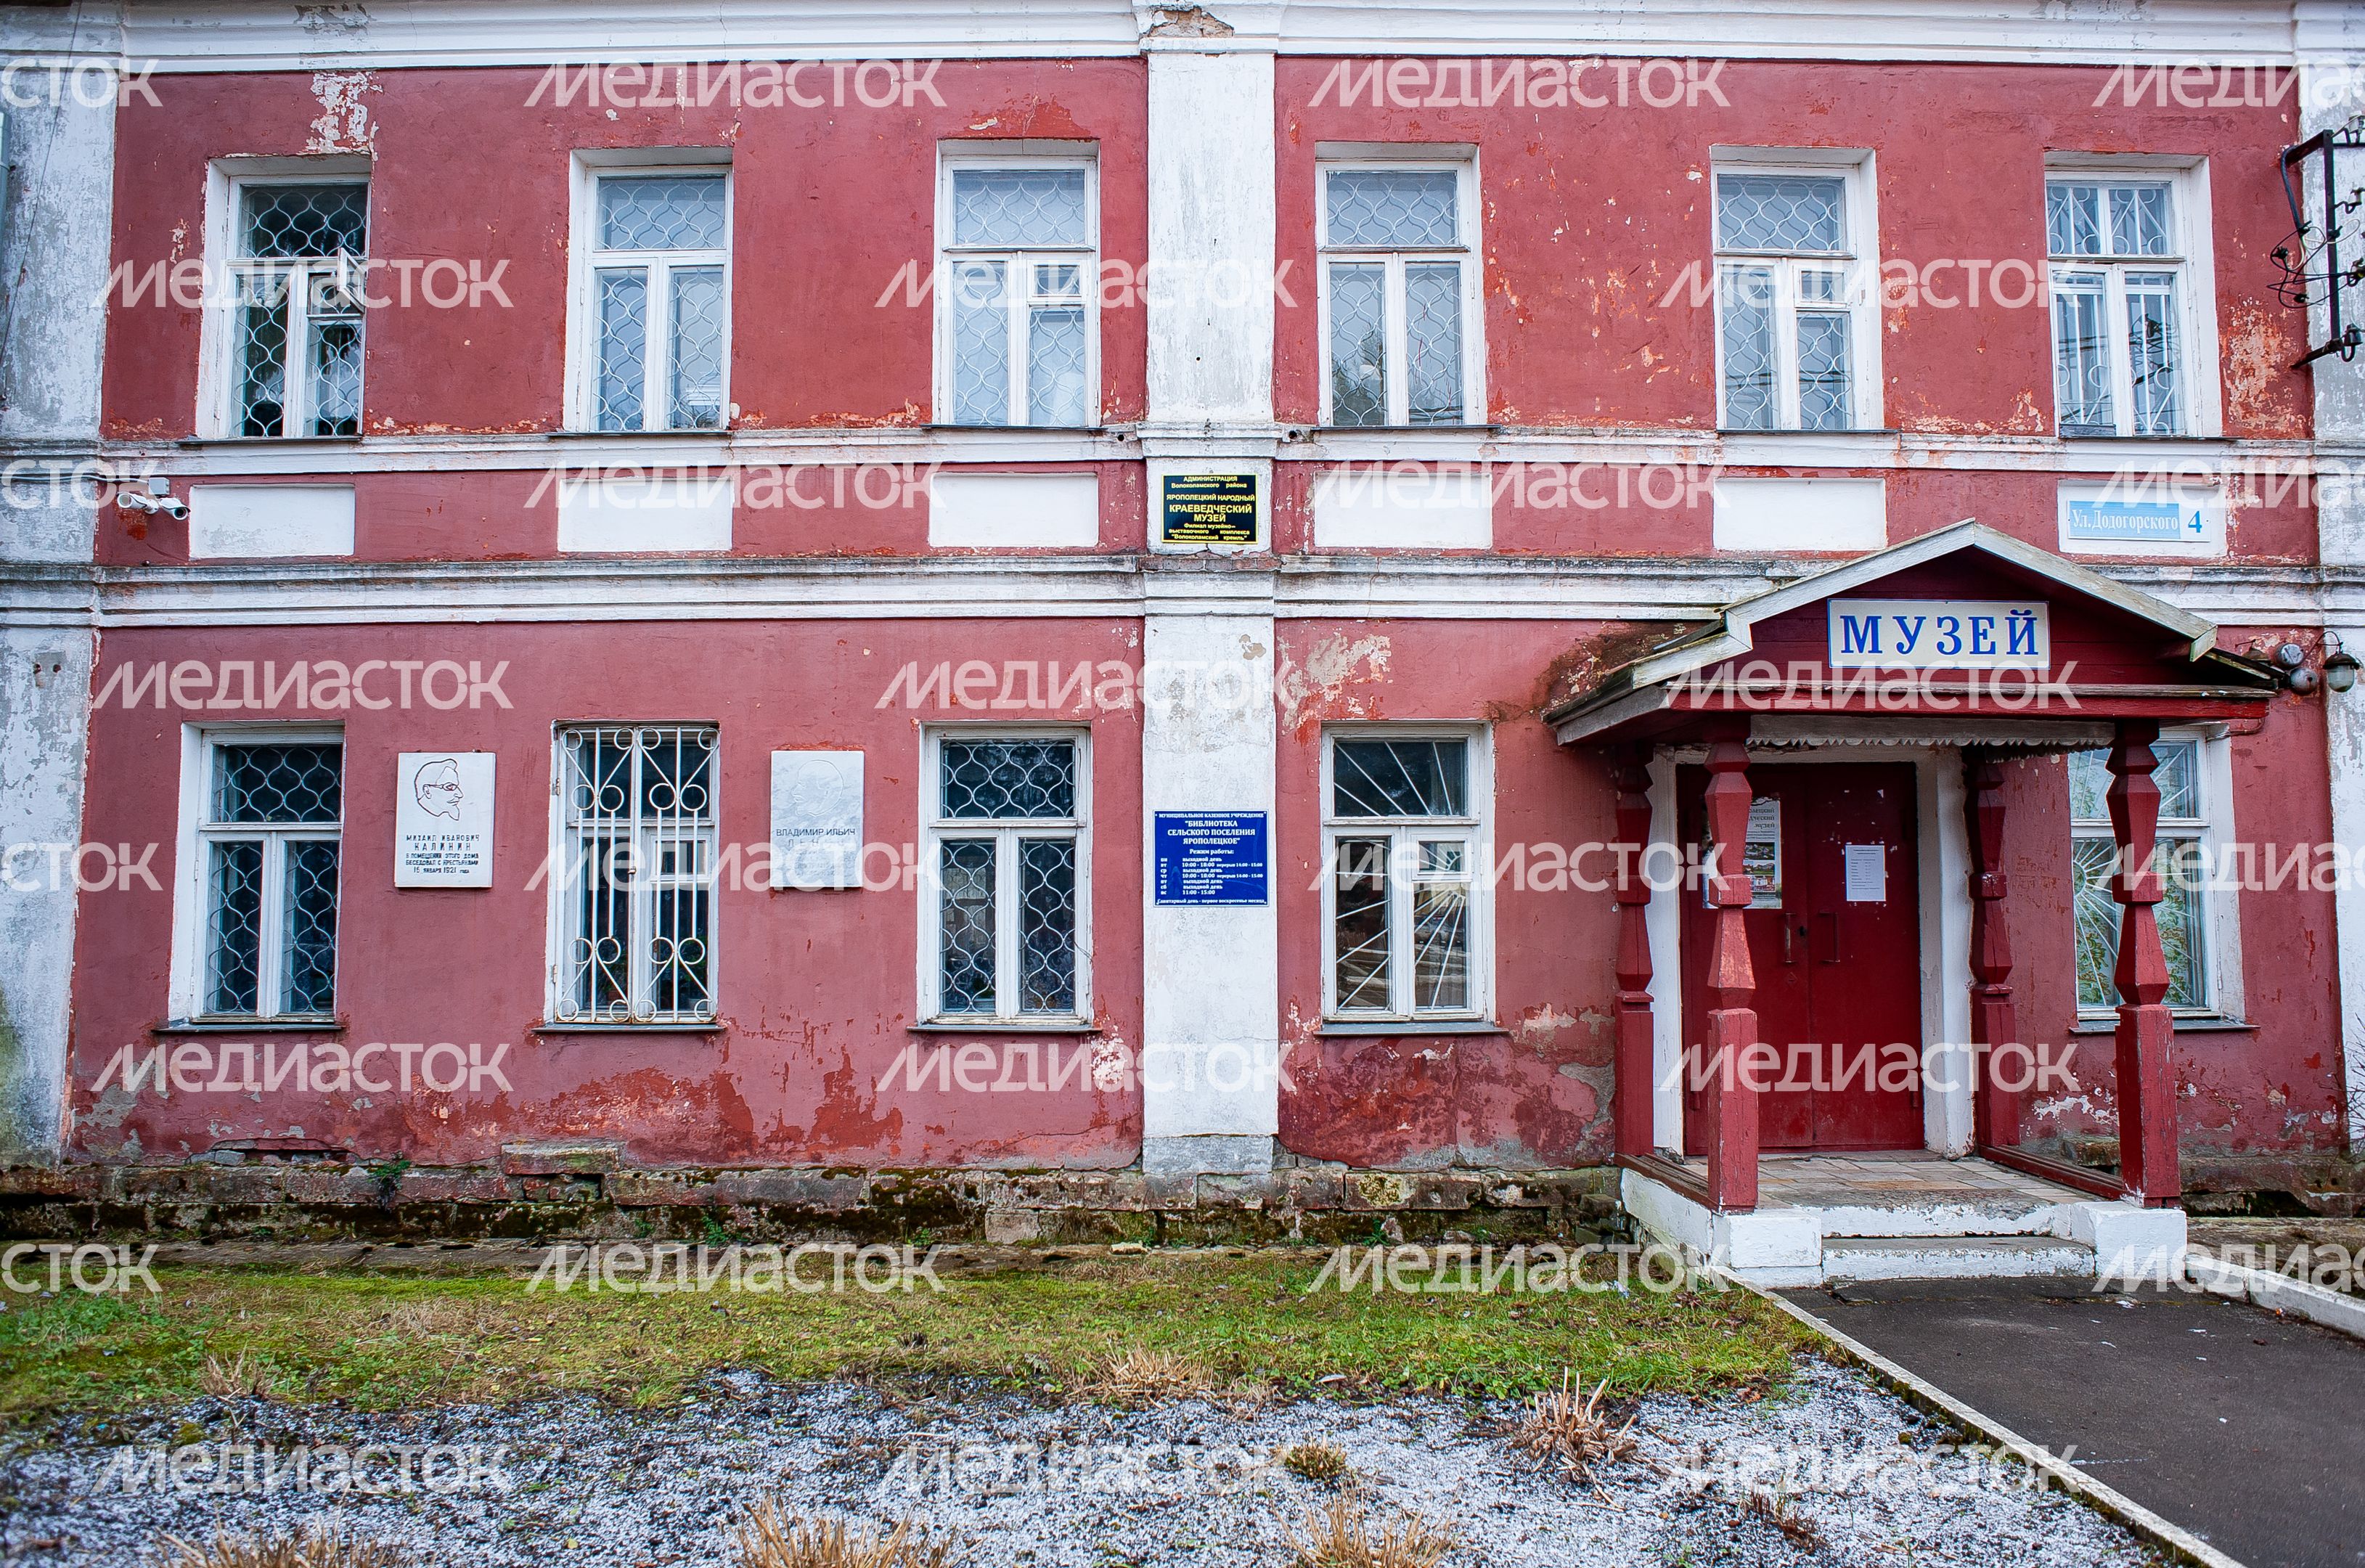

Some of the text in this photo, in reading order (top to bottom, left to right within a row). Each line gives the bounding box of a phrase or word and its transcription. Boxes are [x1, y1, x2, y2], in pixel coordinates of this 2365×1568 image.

[1169, 504, 1252, 513] КРАЕВЕДЧЕСКИЙ
[1193, 513, 1226, 522] МУЗЕЙ
[2188, 510, 2202, 533] 4
[1839, 609, 2039, 656] МУЗЕЙ
[414, 842, 471, 851] КАЛИНИН
